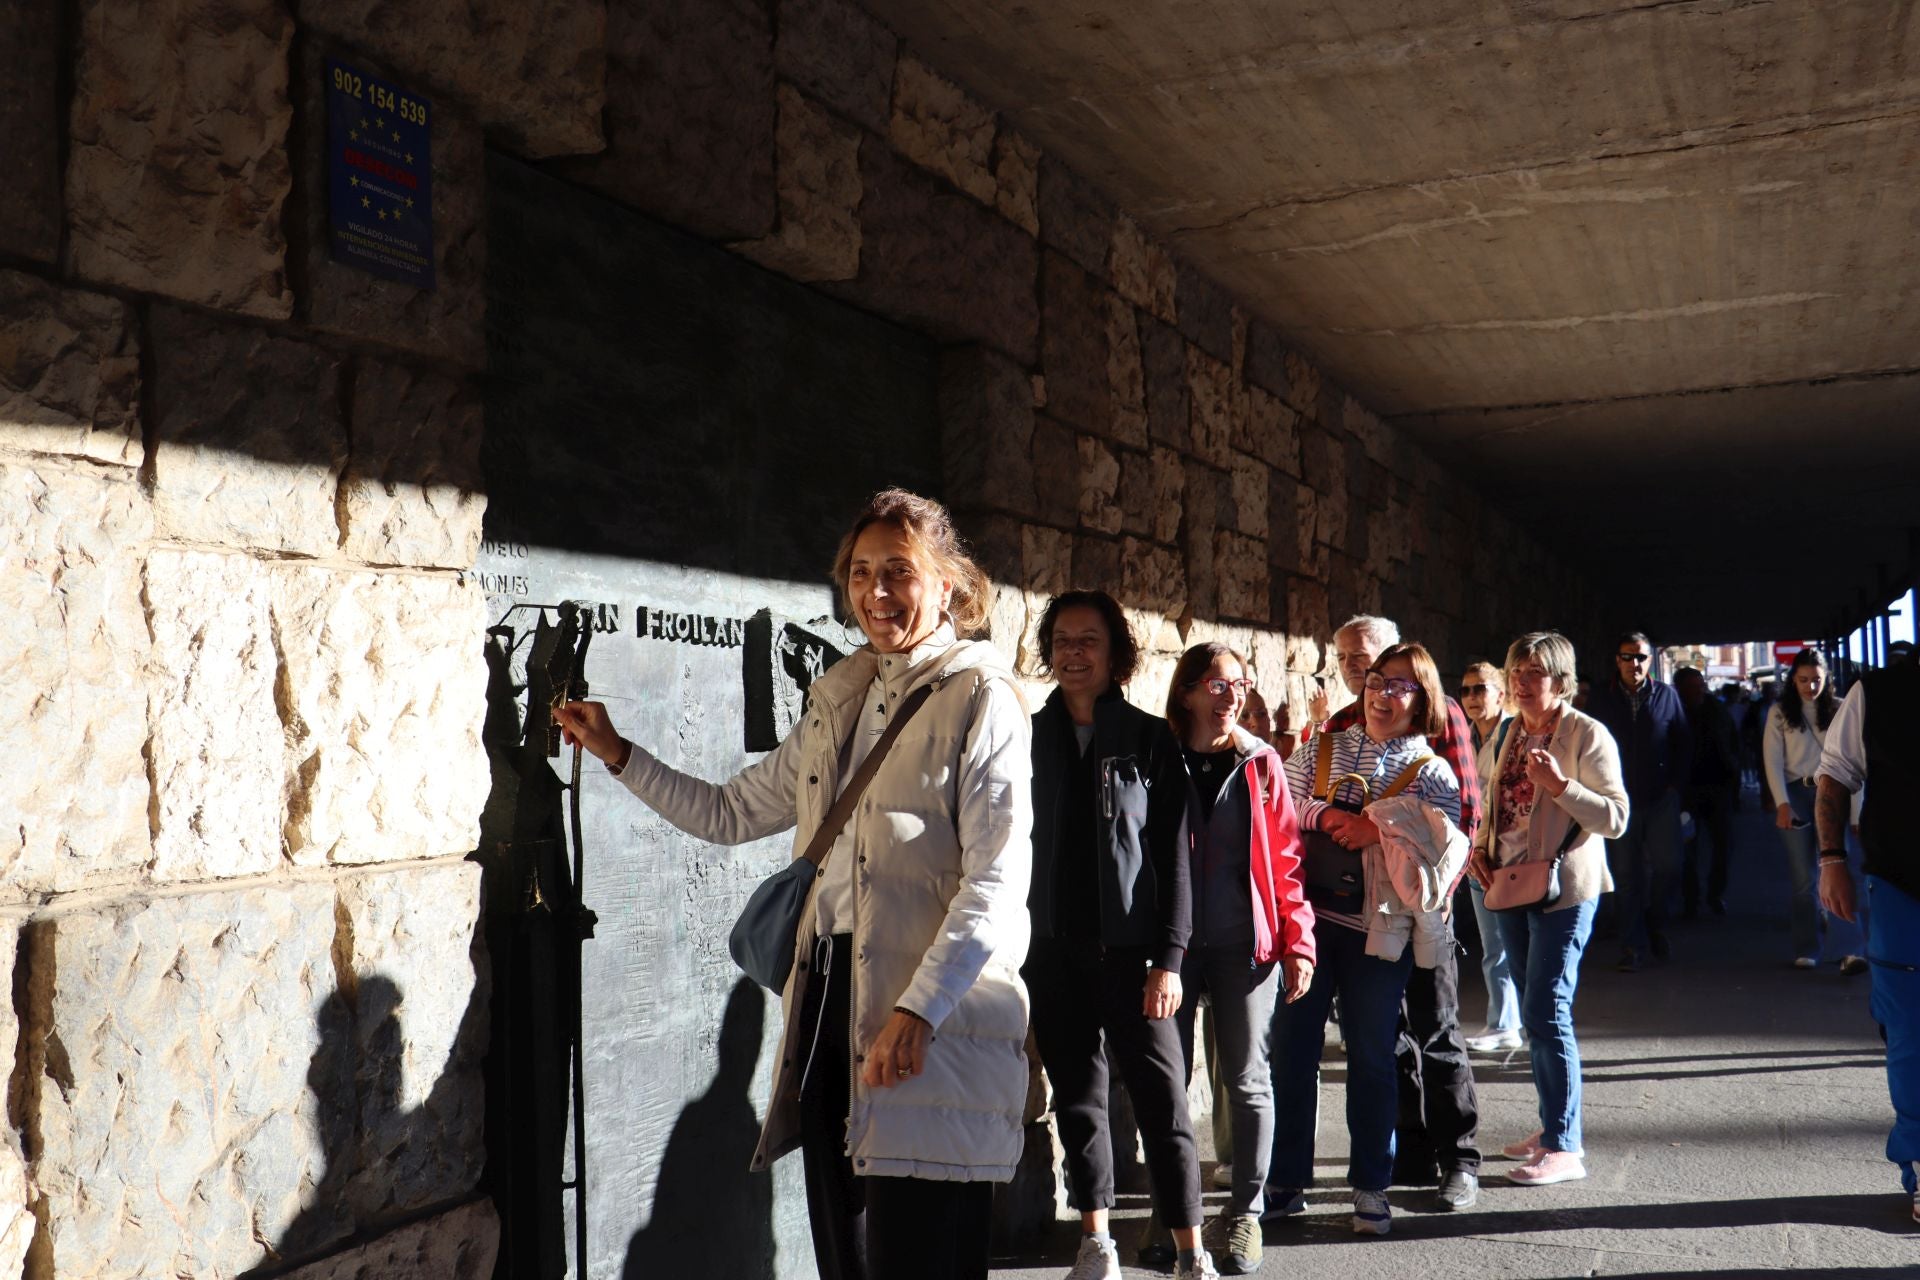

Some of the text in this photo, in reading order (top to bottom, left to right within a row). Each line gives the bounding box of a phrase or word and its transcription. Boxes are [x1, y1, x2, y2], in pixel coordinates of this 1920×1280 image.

[334, 67, 426, 127] 902 154 539
[347, 220, 418, 253] VIGILADO 24 HORAS
[644, 606, 745, 646] FROILAN
